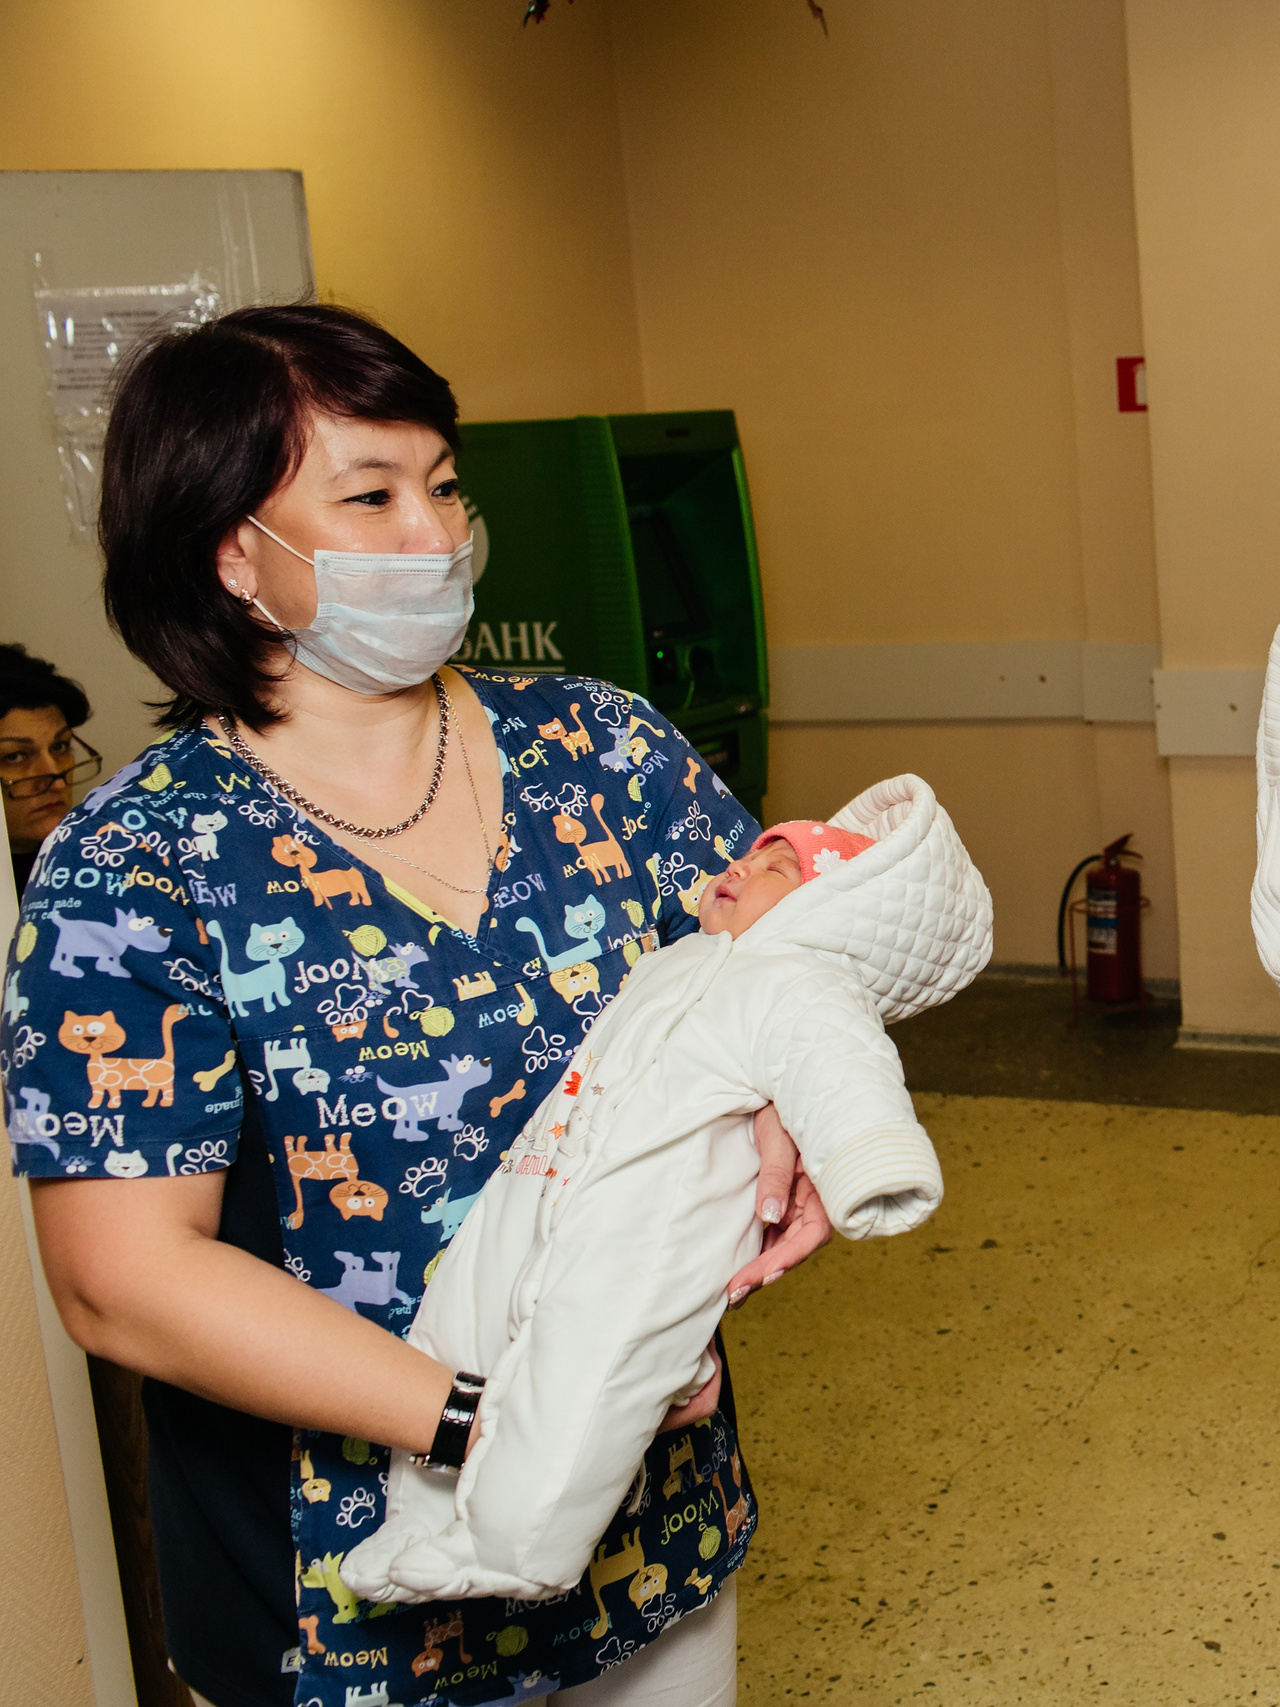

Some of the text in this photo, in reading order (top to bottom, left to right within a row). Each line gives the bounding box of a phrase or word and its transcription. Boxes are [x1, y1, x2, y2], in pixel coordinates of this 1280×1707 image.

[358, 1039, 430, 1062] Meow
[316, 1091, 439, 1129] Meow
[660, 1490, 720, 1547] Woof
[324, 1647, 388, 1669] Meow
[433, 1660, 498, 1691] Meow
